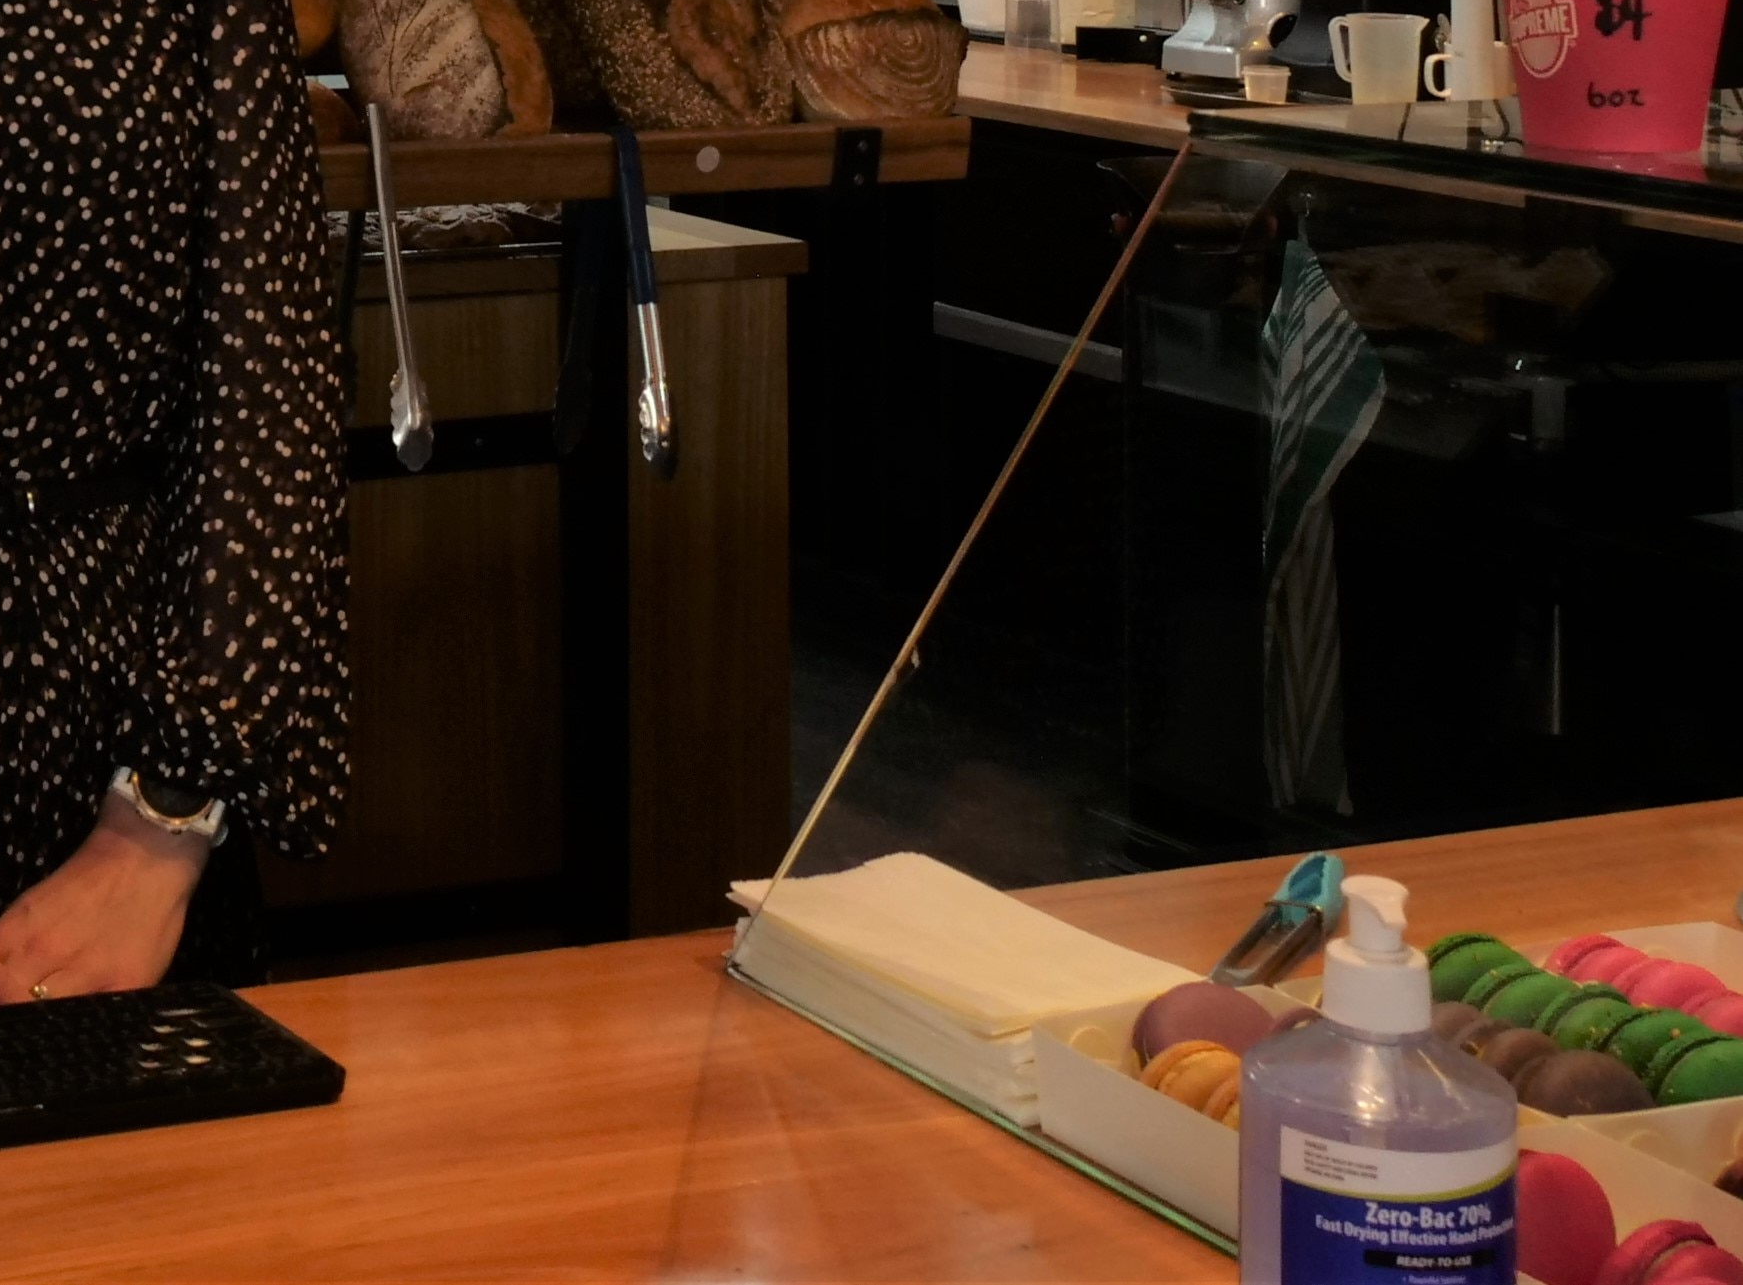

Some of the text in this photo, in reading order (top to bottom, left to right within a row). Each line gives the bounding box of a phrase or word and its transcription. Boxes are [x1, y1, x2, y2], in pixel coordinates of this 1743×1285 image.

[1315, 1214, 1343, 1234] Fast
[1343, 1220, 1390, 1246] Drying
[1390, 1228, 1448, 1246] Effective
[1448, 1228, 1478, 1245] Hand
[1365, 1201, 1492, 1229] Zero-Bac 70%
